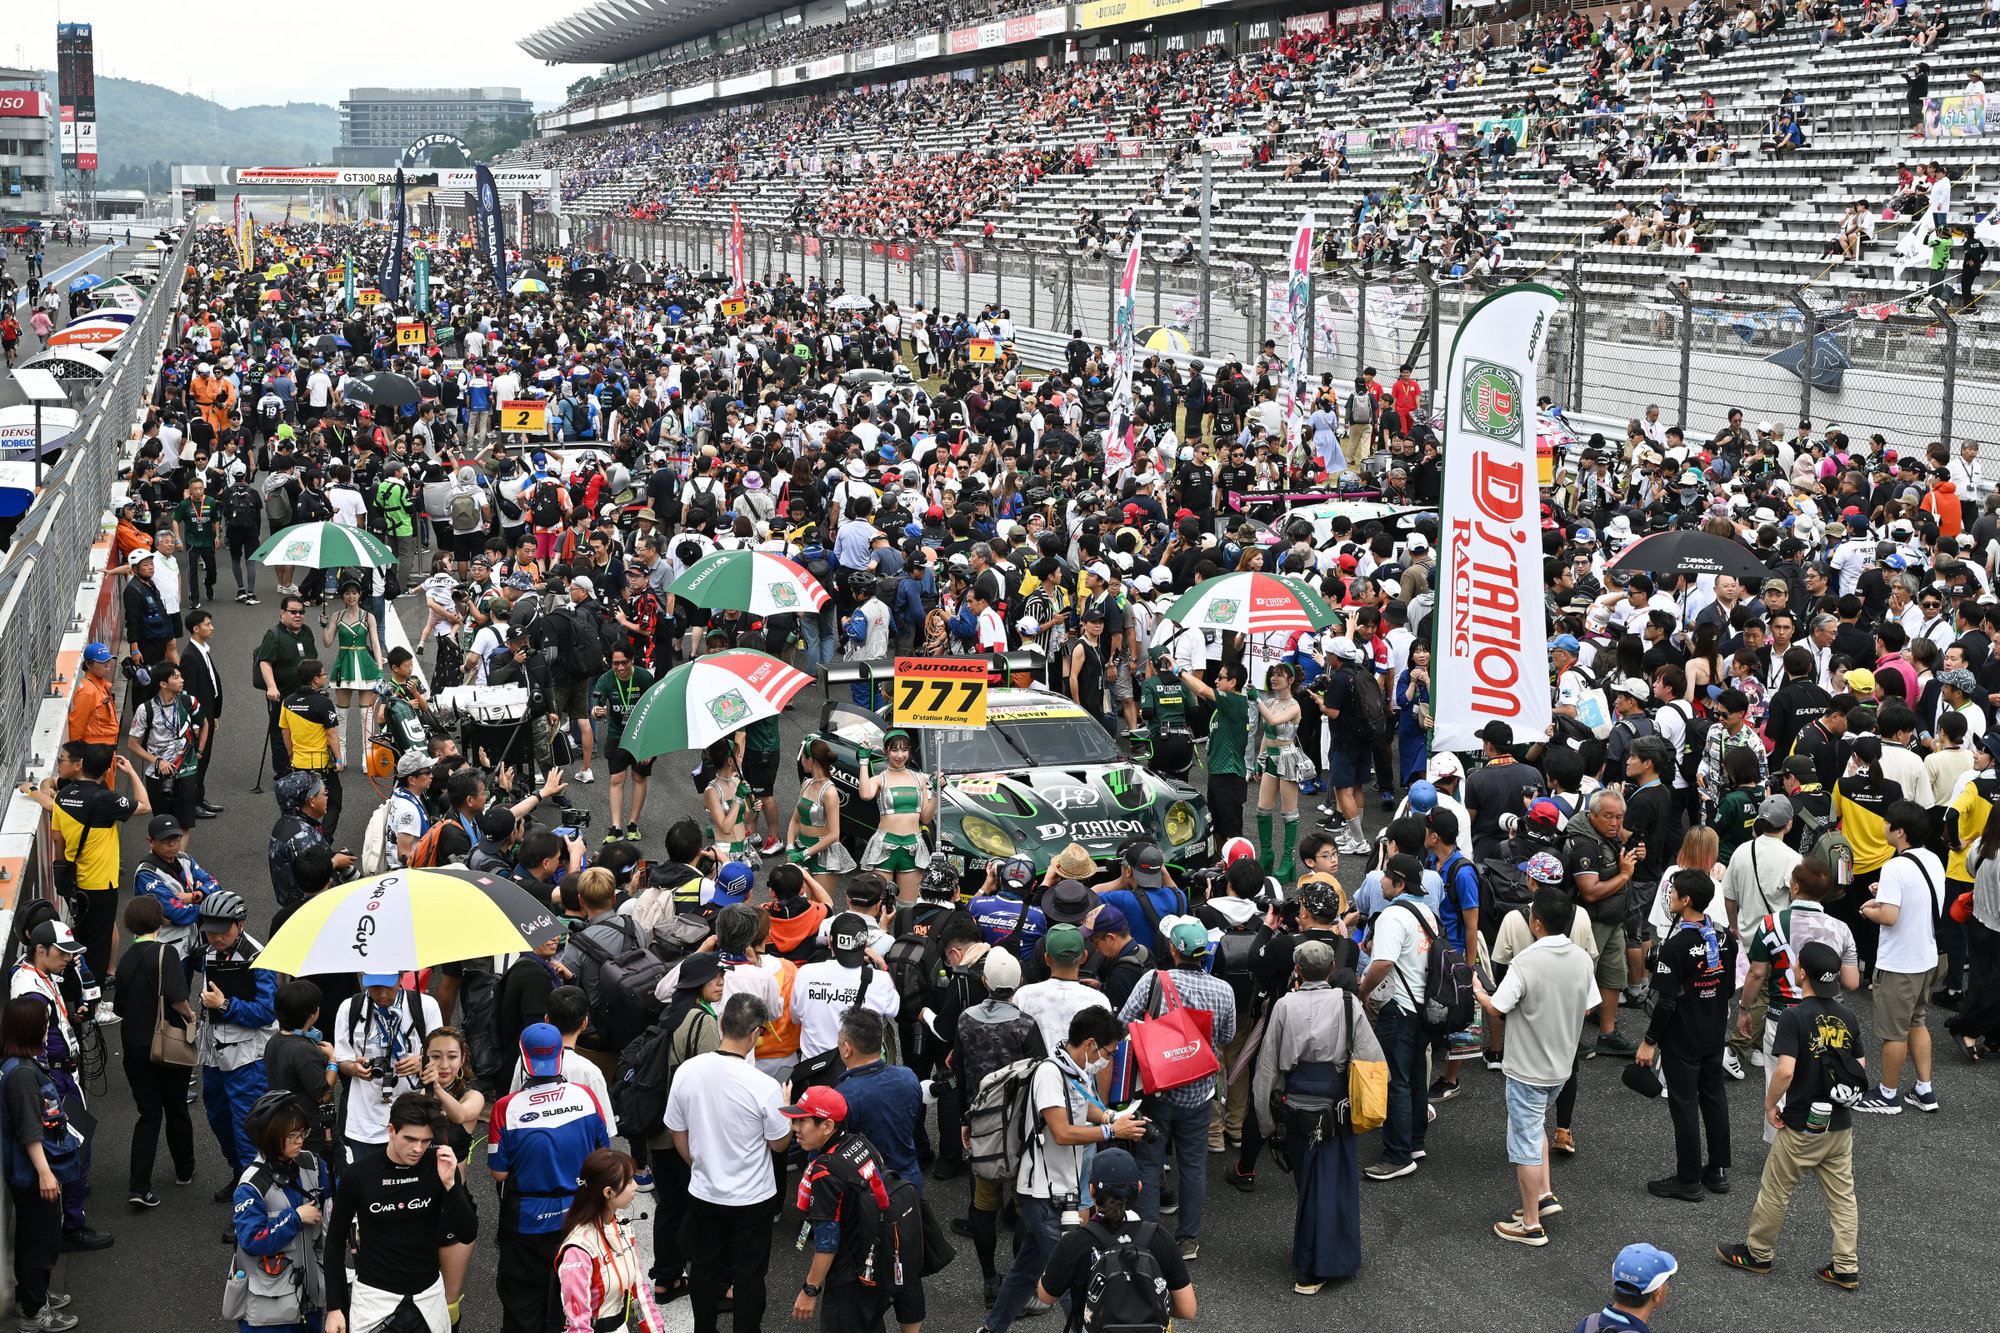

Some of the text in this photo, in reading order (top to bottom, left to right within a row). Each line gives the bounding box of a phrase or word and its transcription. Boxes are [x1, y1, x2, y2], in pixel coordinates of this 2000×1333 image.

[1100, 4, 1126, 18] DUNLOP
[978, 28, 1005, 44] NISSAN
[1006, 20, 1035, 40] NISSAN
[1206, 29, 1226, 46] ARTA
[1248, 22, 1270, 40] ARTA
[952, 32, 978, 48] NISSAN
[1166, 36, 1184, 50] ARTA
[1096, 48, 1110, 60] ARTA
[1130, 42, 1146, 54] ARTA
[408, 134, 471, 158] POTENZA
[344, 173, 376, 182] GT300
[486, 214, 498, 268] SUBAR
[384, 220, 399, 280] SUBARU
[731, 304, 736, 312] 5
[92, 332, 100, 340] X
[404, 330, 418, 340] 61
[980, 347, 986, 357] 7
[50, 363, 64, 377] 96
[1476, 376, 1490, 421] STATION
[266, 407, 277, 416] 19
[517, 411, 530, 425] 2
[688, 556, 730, 590] D'STATION
[1452, 516, 1472, 658] RACING
[1472, 450, 1526, 718] D'STATION
[1255, 597, 1291, 606] D'STATION
[1280, 578, 1323, 618] D'STATION
[515, 628, 522, 636] S
[913, 664, 984, 672] AUTOBACS
[898, 680, 984, 712] 777
[829, 765, 859, 786] RACIN
[1036, 820, 1146, 840] D'STATION
[1072, 832, 1128, 841] RACING
[352, 877, 398, 957] CAR GUY
[1694, 978, 1720, 987] HONDA
[531, 1044, 556, 1055] STI
[529, 1086, 565, 1106] STI
[542, 1105, 583, 1118] SUBARU
[235, 1197, 254, 1214] GTA
[369, 1198, 431, 1213] CAR GUY
